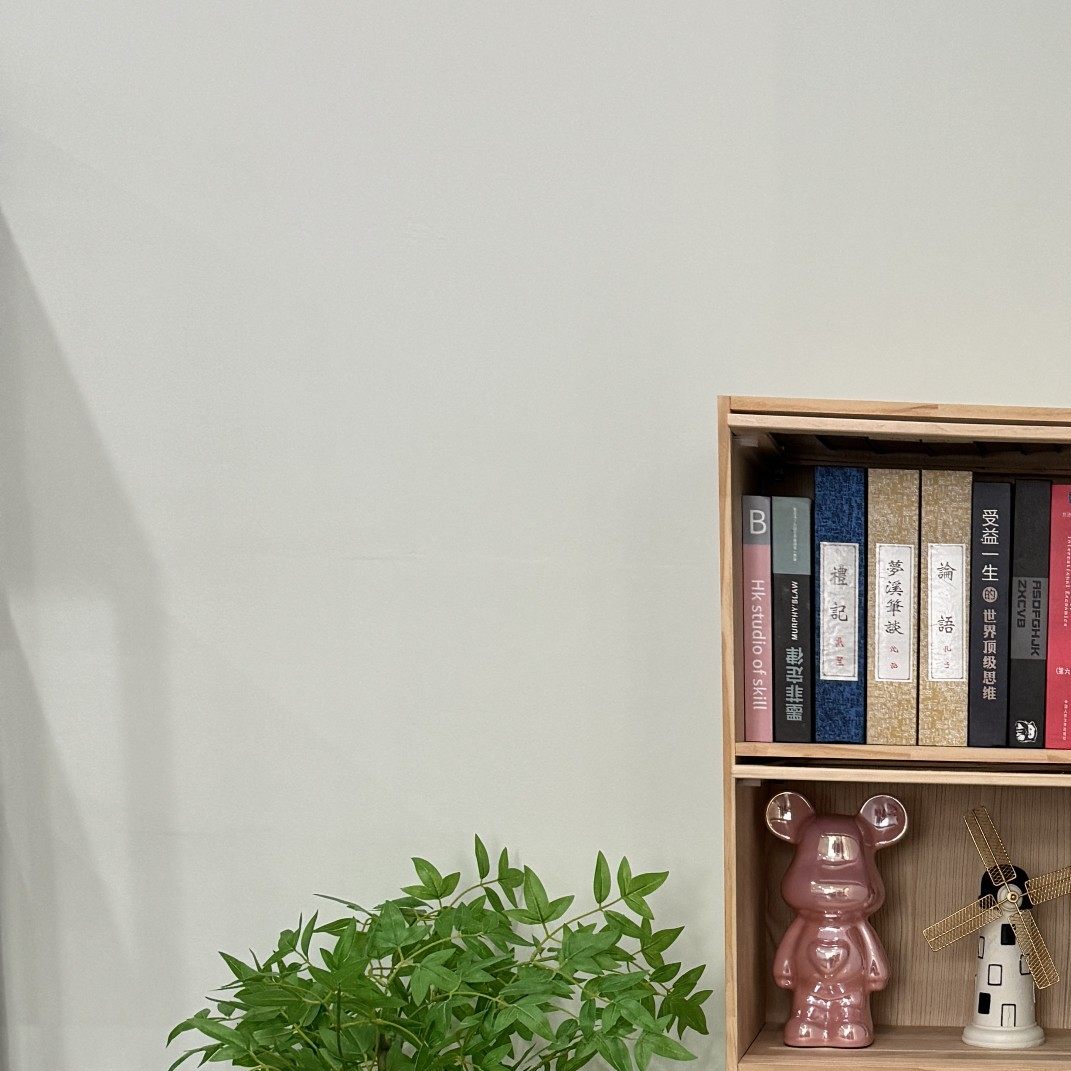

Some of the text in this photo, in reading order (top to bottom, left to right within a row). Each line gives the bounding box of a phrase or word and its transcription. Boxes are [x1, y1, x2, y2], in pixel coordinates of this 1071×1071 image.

[749, 509, 767, 534] B
[829, 563, 848, 622] 禮記
[884, 559, 904, 635] 夢溪筆談
[937, 561, 957, 634] 論語
[1017, 579, 1027, 628] ZXCVB
[1030, 580, 1042, 657] ASDFGHJK
[751, 580, 768, 710] Hk studio of skill
[785, 646, 804, 721] 墨菲定律
